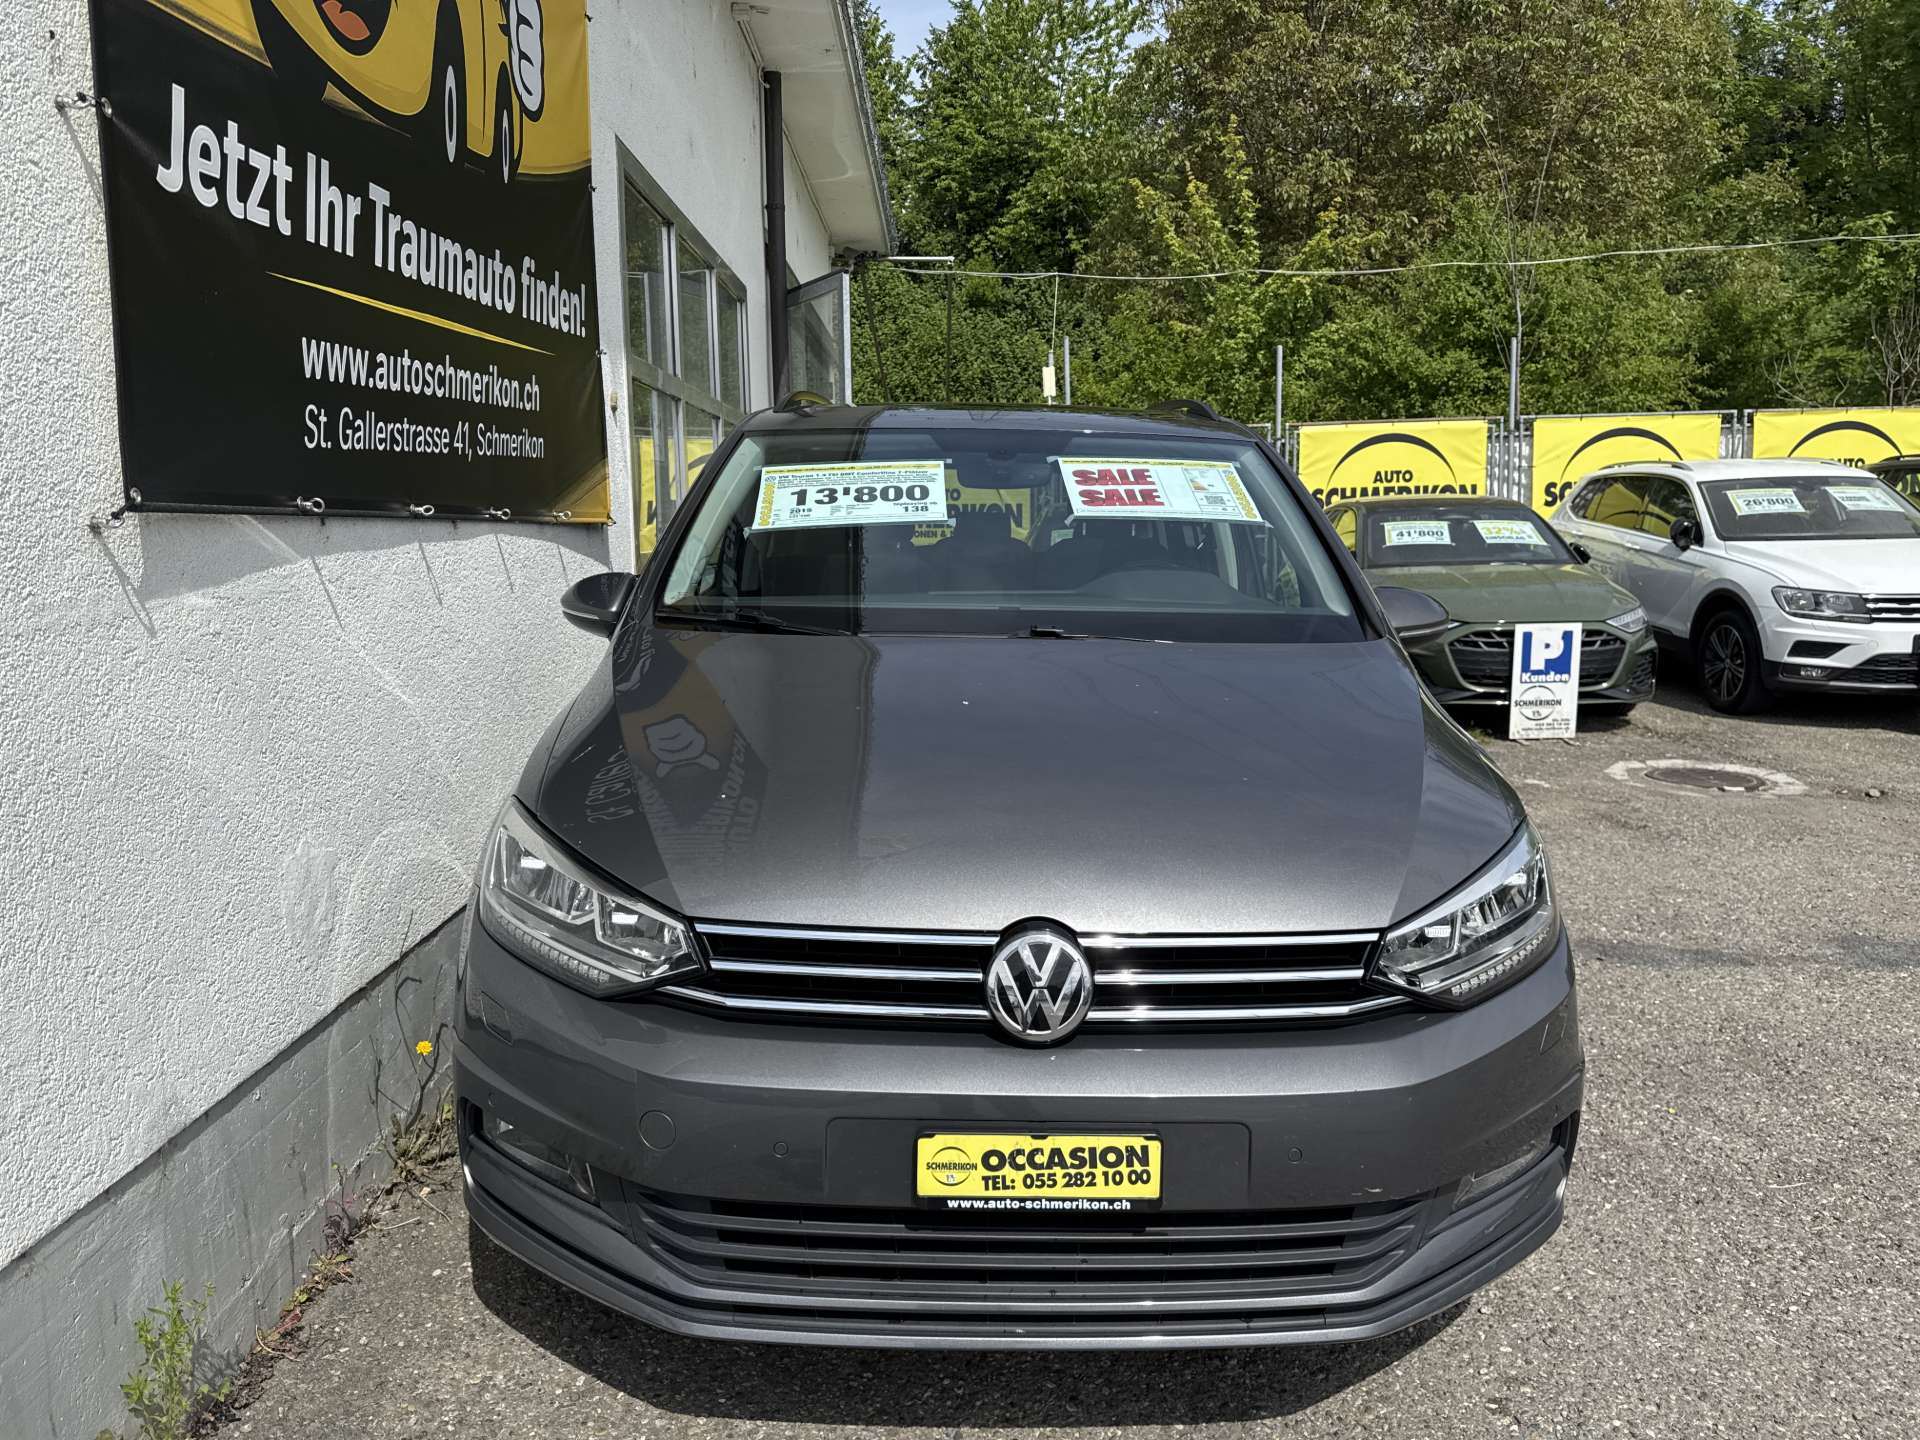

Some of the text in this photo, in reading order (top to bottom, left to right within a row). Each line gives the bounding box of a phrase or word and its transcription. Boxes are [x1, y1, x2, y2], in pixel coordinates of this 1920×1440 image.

[156, 83, 586, 338] Jetzt Ihr Traumauto finden!
[302, 337, 541, 412] www.autoschmerikon.ch
[304, 404, 544, 462] St. Gallerstrasse 41, Schmerikon
[1072, 468, 1156, 487] SALE
[1373, 470, 1413, 483] AUTO
[790, 484, 930, 507] 13'800
[1078, 488, 1165, 507] SALE
[902, 505, 930, 513] 138
[1396, 529, 1444, 538] 41'800
[1529, 631, 1565, 671] P
[1521, 671, 1570, 683] Kunden
[1514, 698, 1562, 708] SCHMERIKON
[926, 1161, 978, 1172] SCHMERIKON
[980, 1144, 1150, 1173] OCCASION
[981, 1169, 1151, 1192] TEL: 055 282 10 00
[947, 1198, 1132, 1211] www.auto-schmerikon.ch
